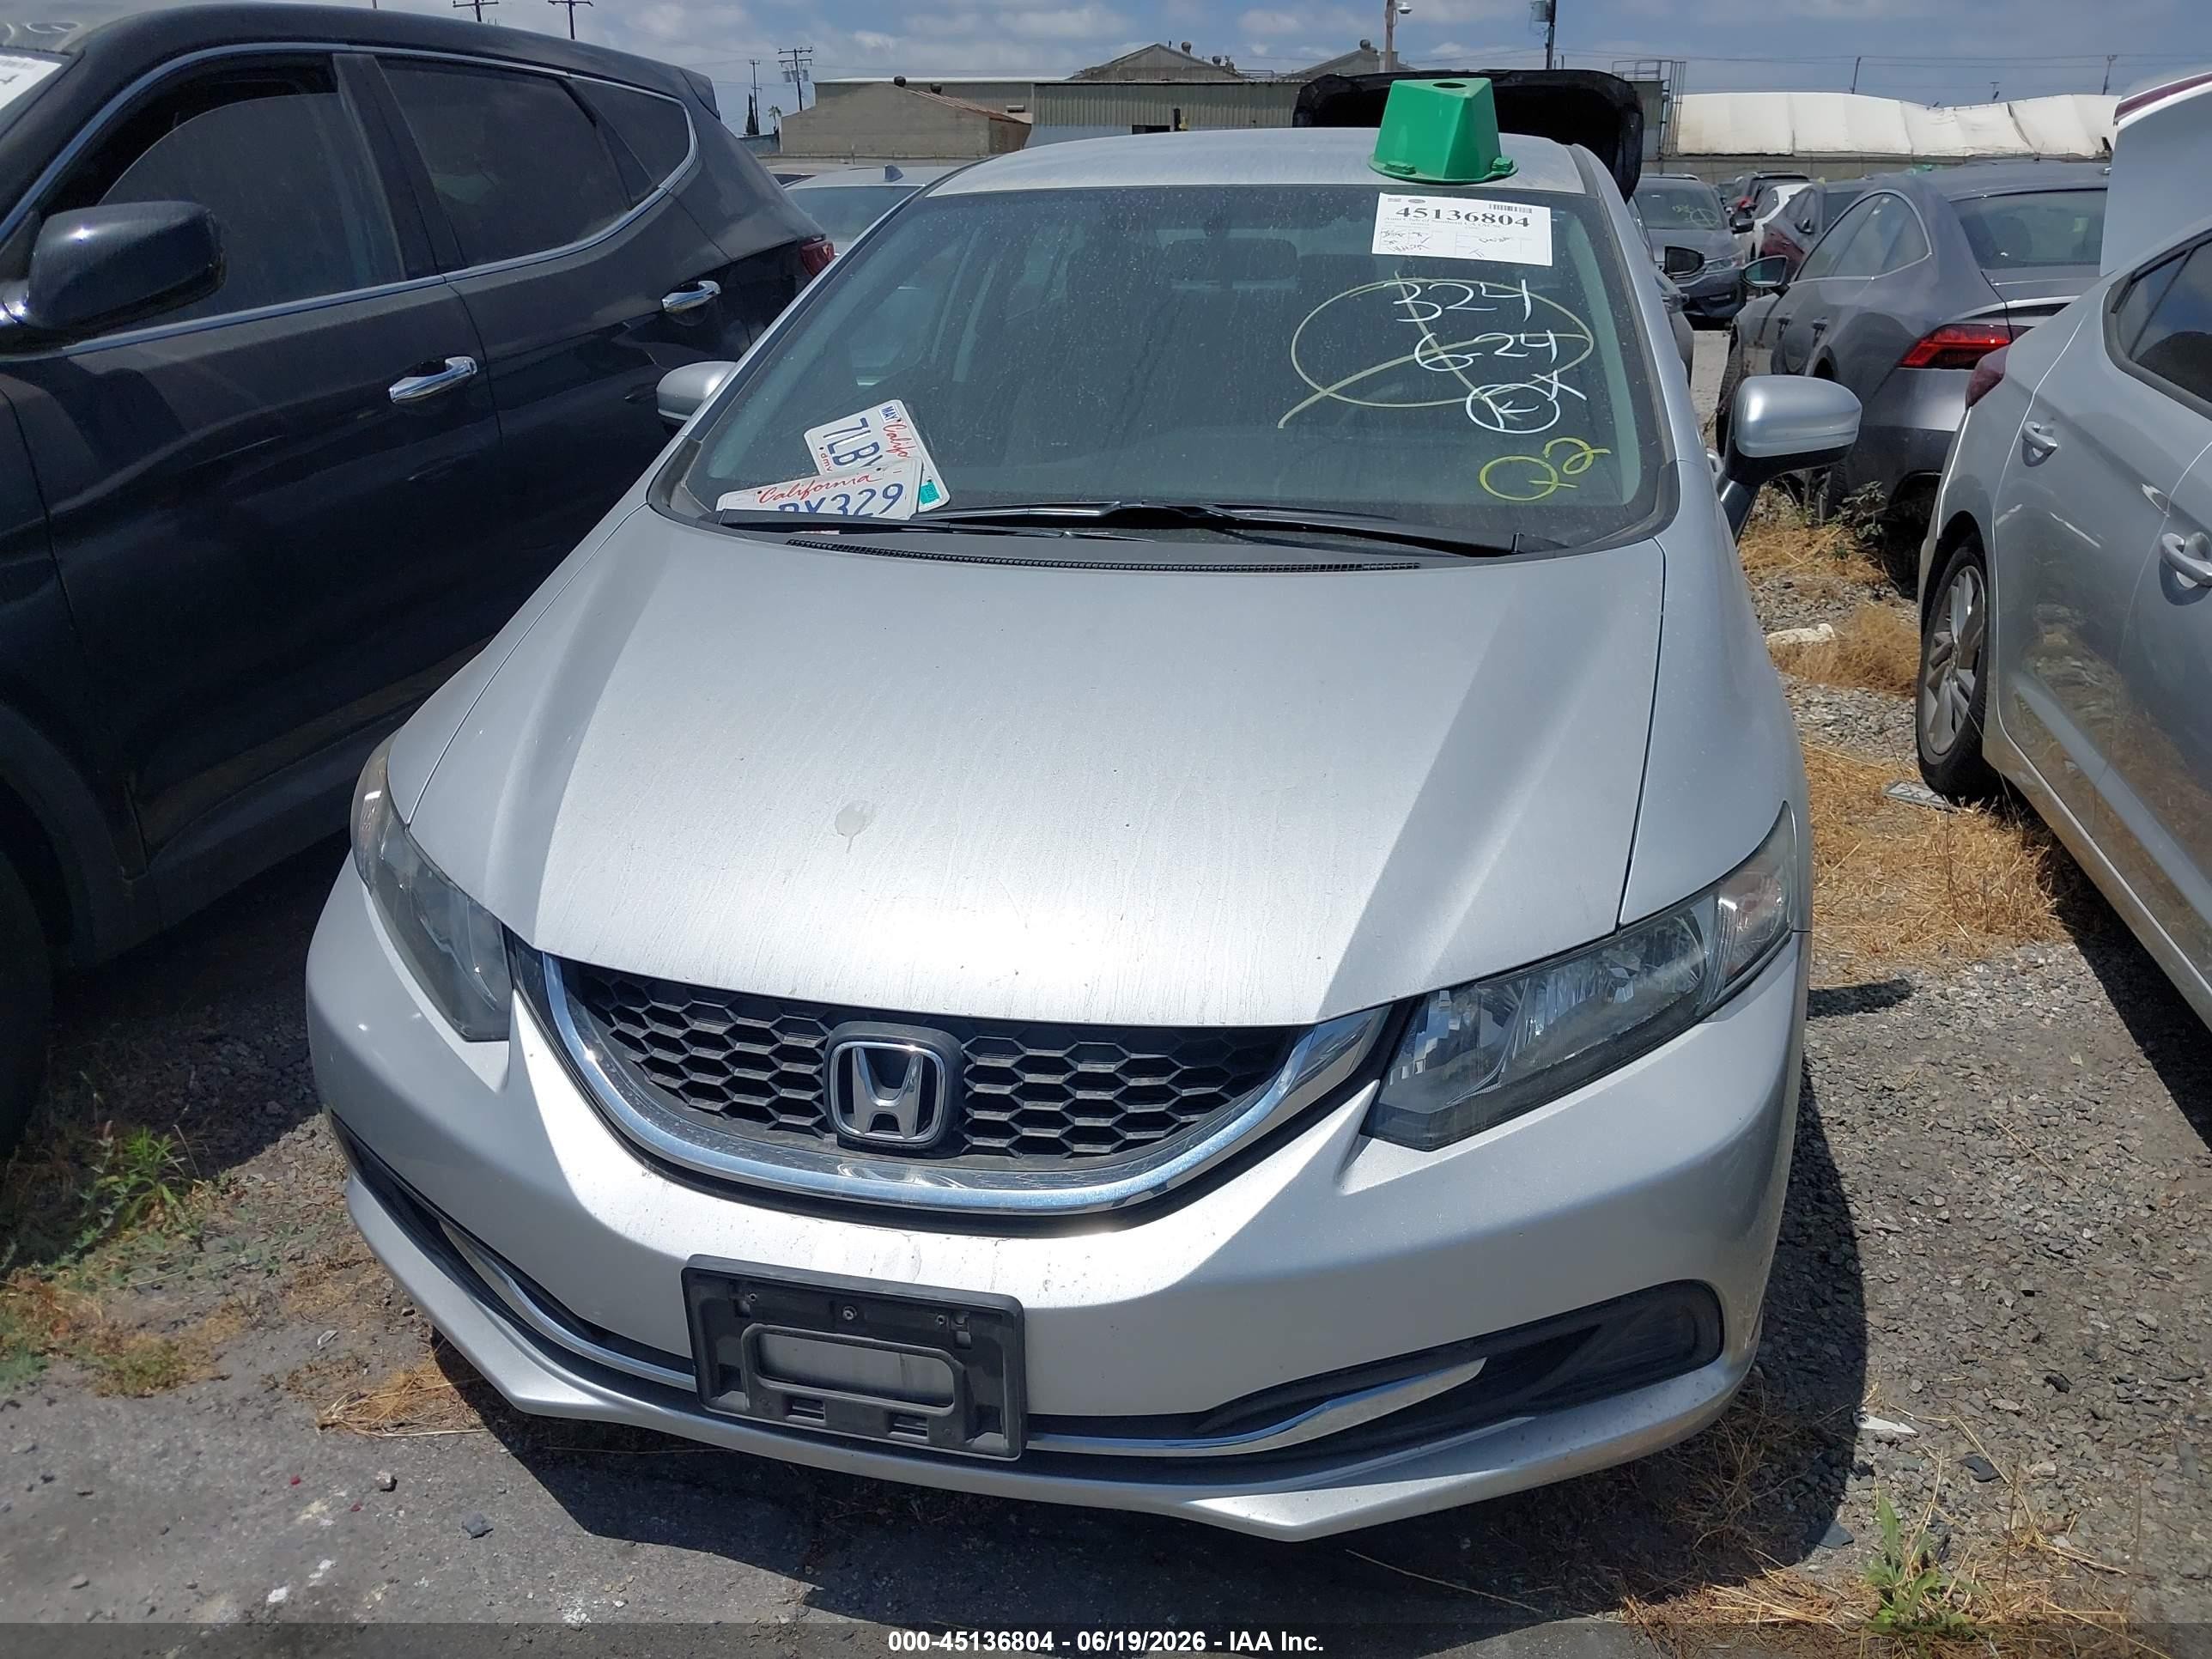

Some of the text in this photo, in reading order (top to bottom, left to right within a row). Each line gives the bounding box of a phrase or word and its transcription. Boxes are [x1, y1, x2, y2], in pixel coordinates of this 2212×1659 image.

[1395, 206, 1530, 228] 45136804
[1383, 278, 1533, 322] 324
[881, 406, 898, 421] MAY
[759, 474, 881, 504] California
